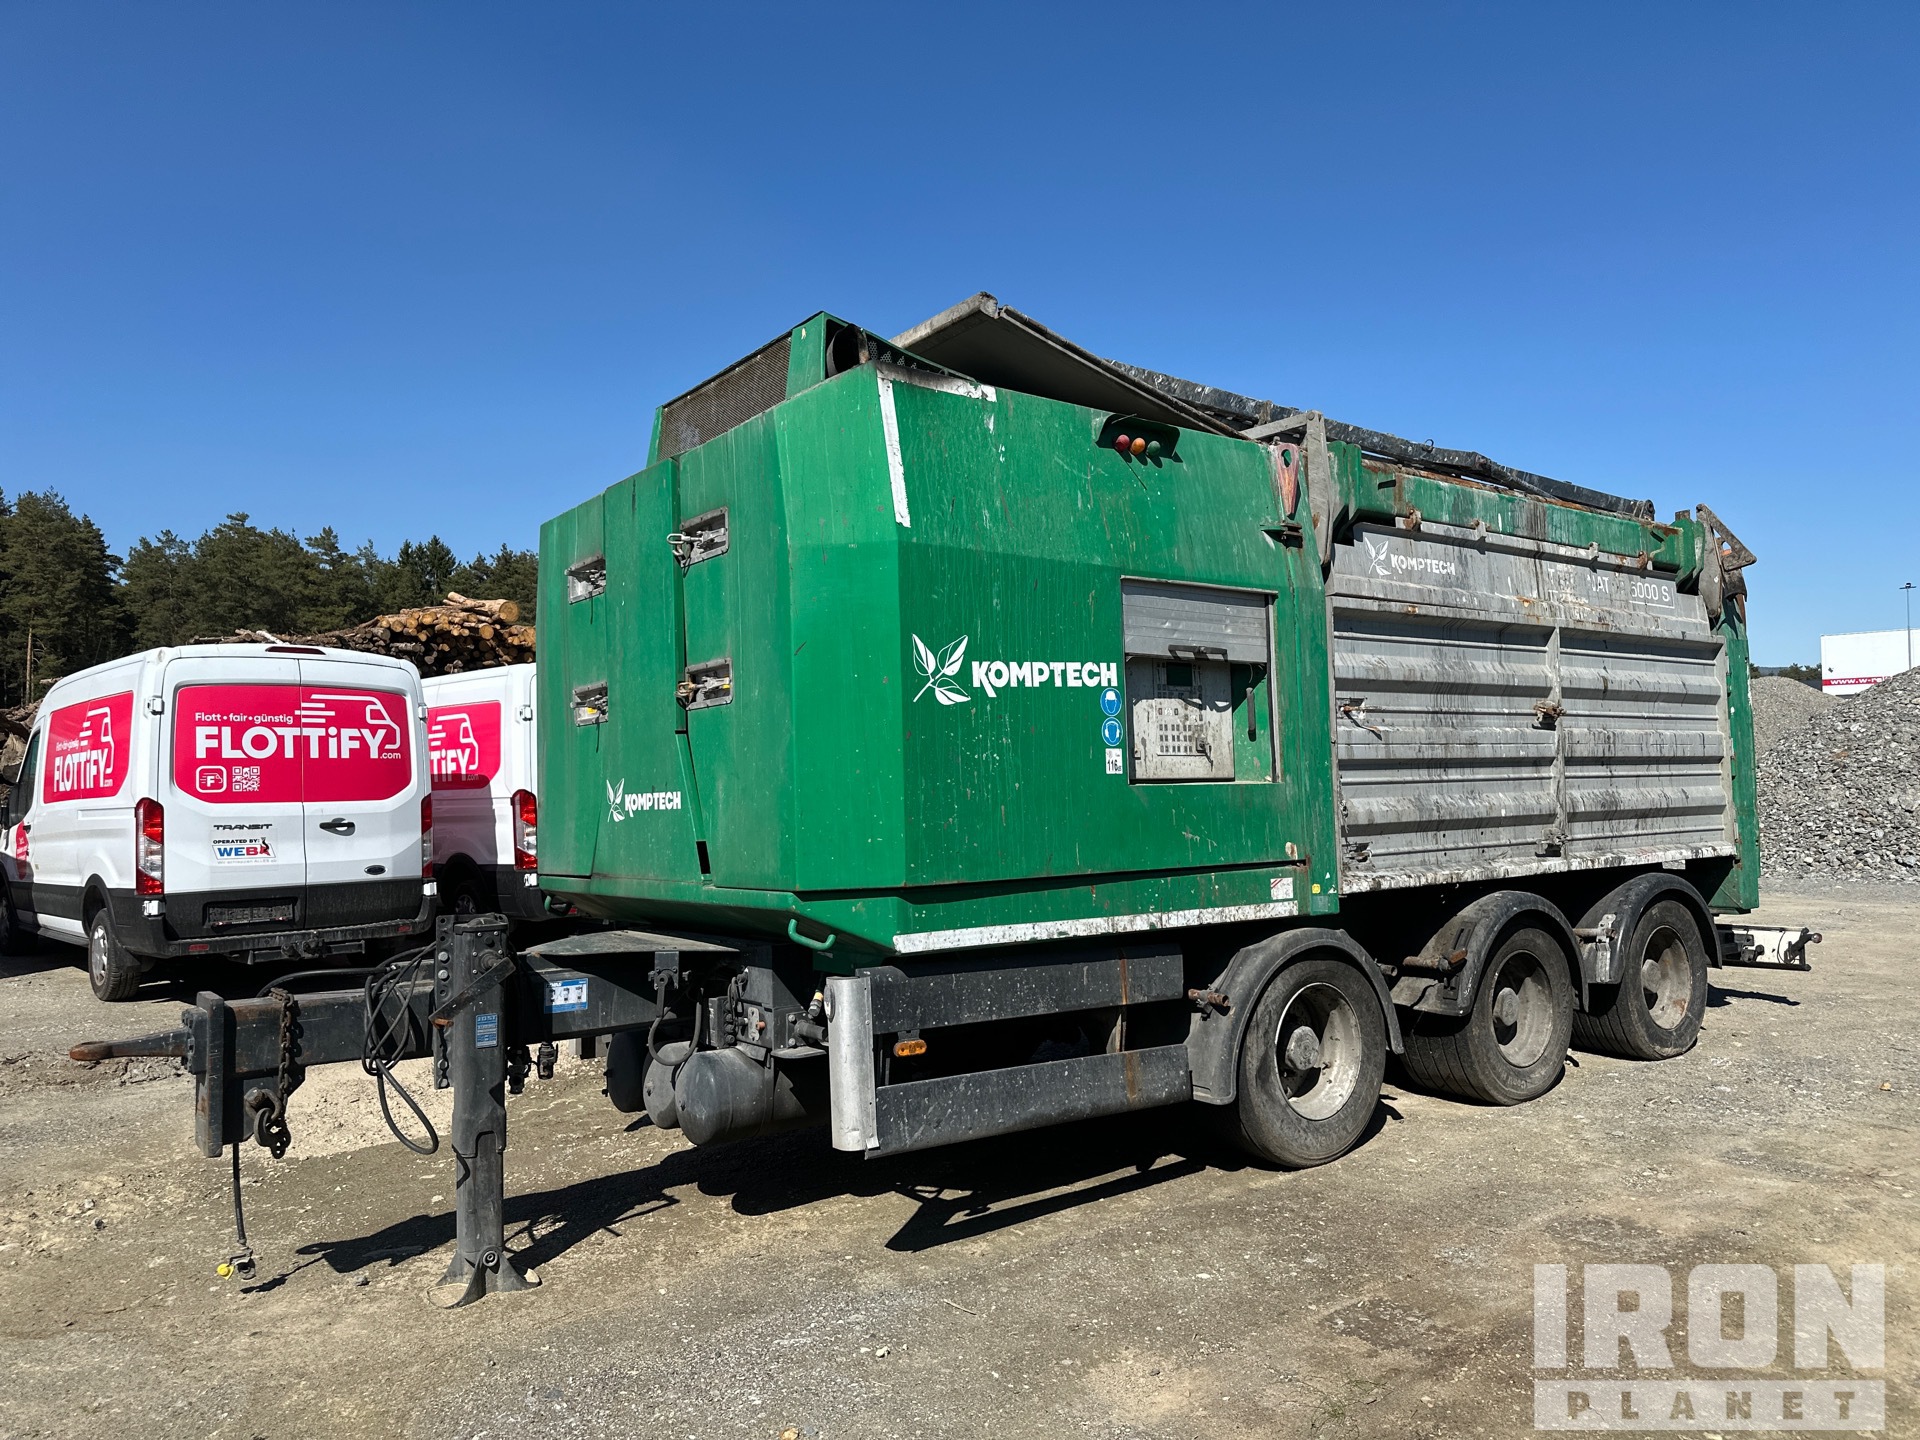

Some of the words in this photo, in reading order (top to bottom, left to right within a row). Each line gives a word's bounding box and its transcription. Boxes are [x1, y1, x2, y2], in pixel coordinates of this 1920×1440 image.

[1390, 553, 1456, 576] KOMPTECH
[1661, 585, 1670, 602] S
[971, 660, 1119, 698] KOMPTECH
[195, 712, 221, 722] Flott
[229, 712, 248, 722] fair
[254, 713, 293, 725] günstig
[624, 791, 682, 817] KOMPTECH
